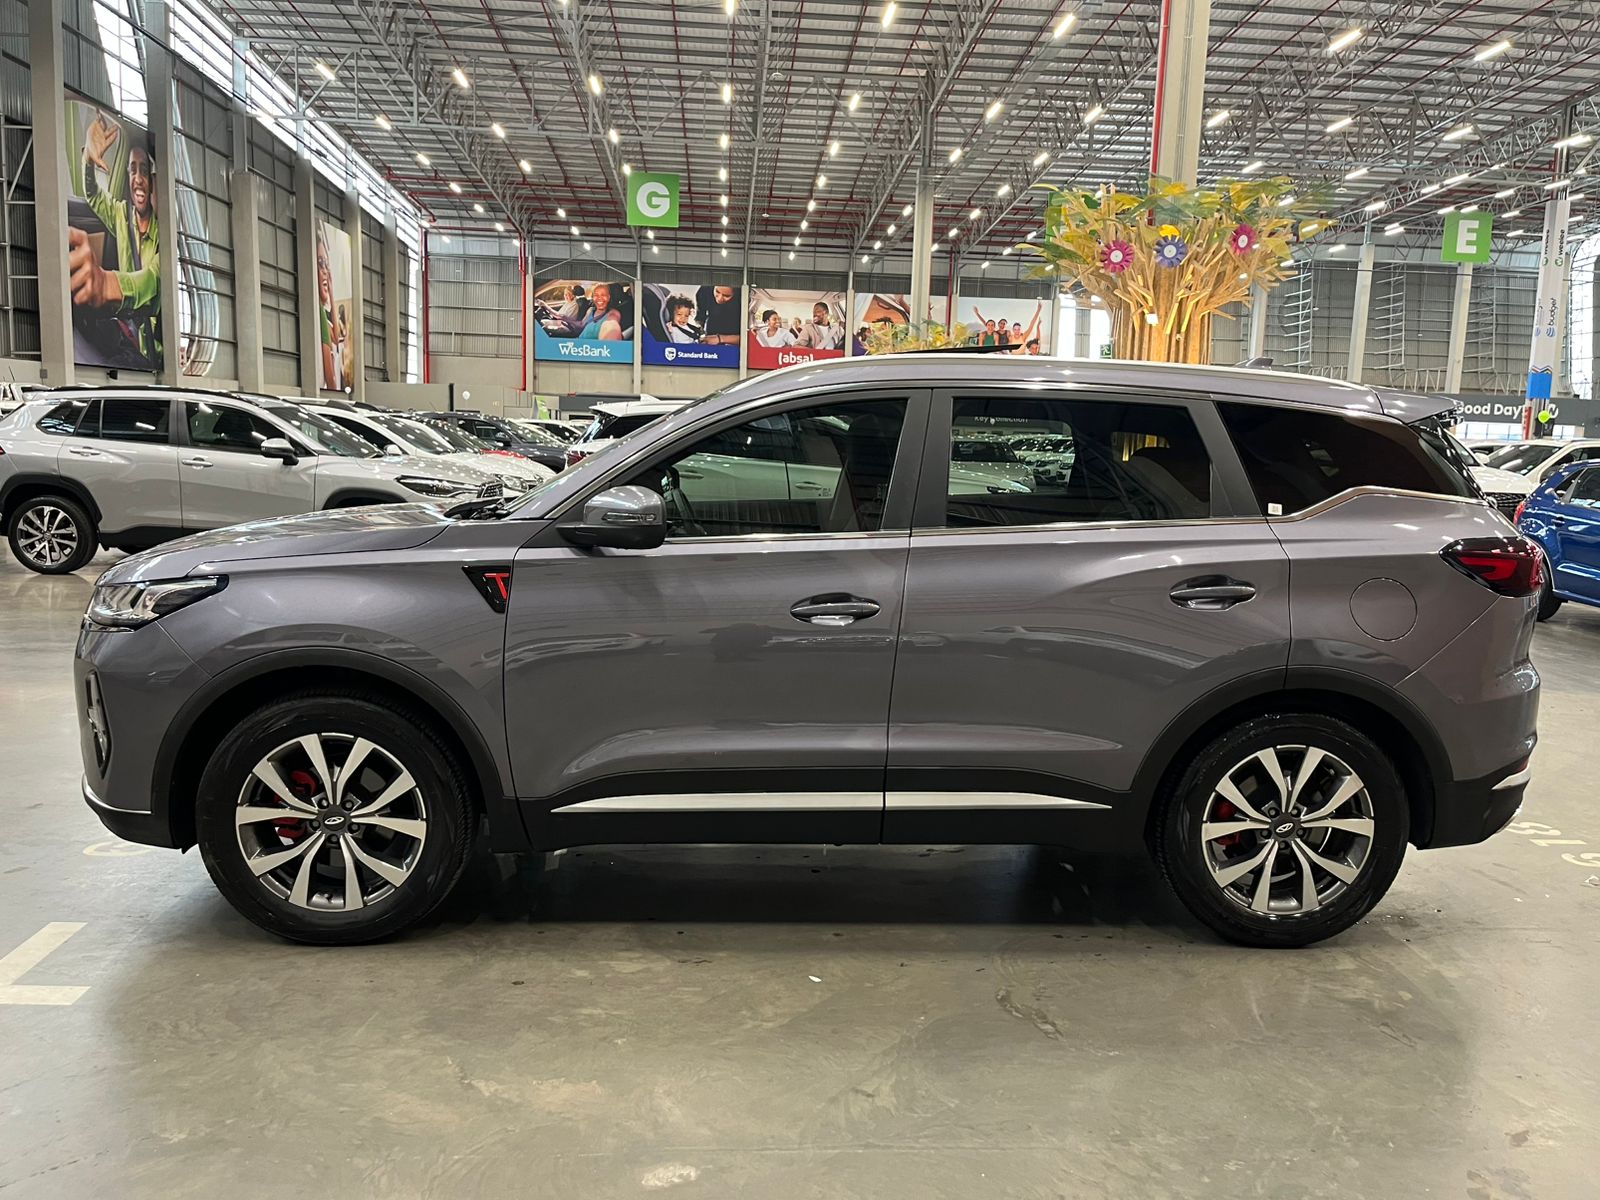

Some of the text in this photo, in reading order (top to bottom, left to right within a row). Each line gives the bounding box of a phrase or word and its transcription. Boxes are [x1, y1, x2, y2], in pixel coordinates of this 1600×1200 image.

[636, 181, 671, 218] G
[1456, 219, 1480, 254] E
[1548, 297, 1557, 326] budget
[558, 341, 611, 358] WesBank
[677, 351, 719, 360] Standard Bank
